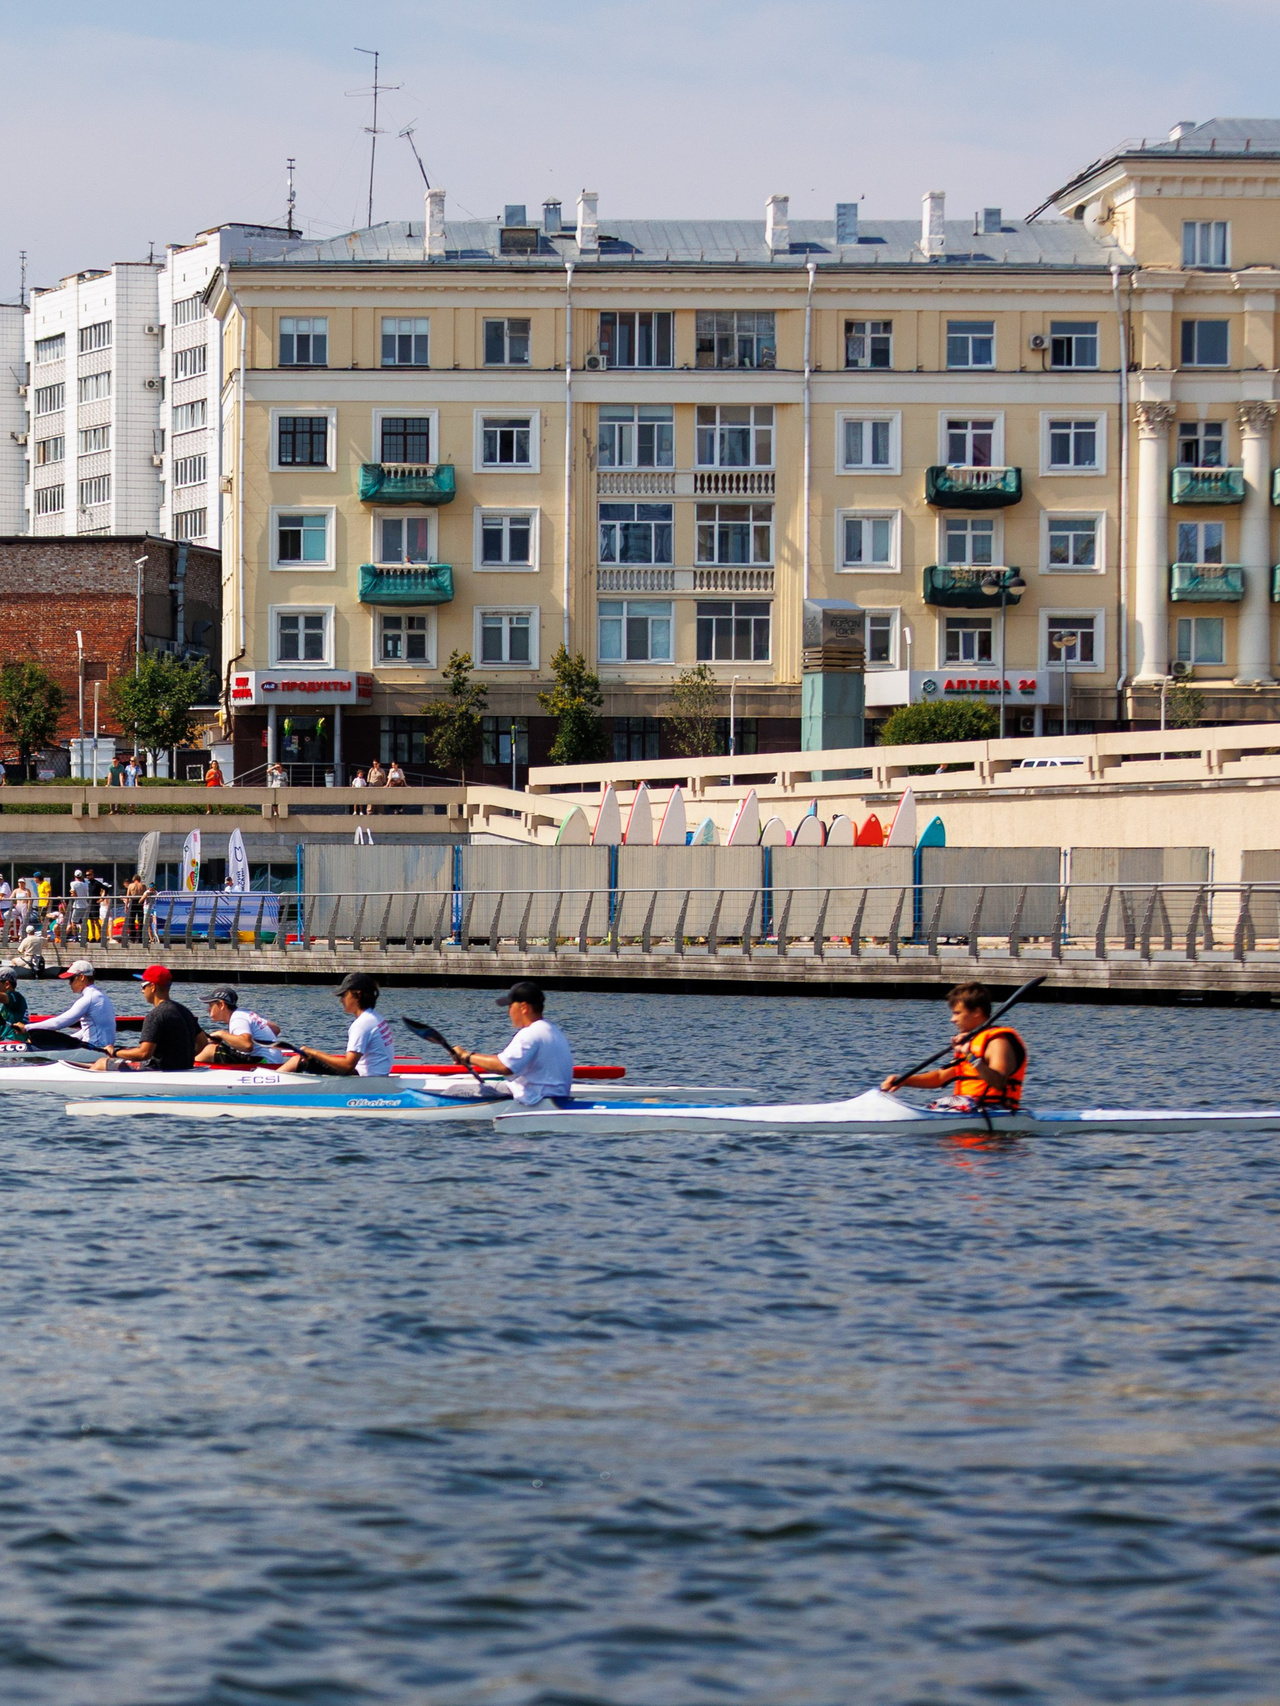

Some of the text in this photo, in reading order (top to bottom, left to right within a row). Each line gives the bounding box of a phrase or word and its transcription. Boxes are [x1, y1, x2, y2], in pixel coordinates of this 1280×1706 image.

[281, 681, 352, 692] ПРОДУКТЫ
[943, 679, 1038, 690] АПТЕКА 24
[237, 1075, 280, 1084] ECSI
